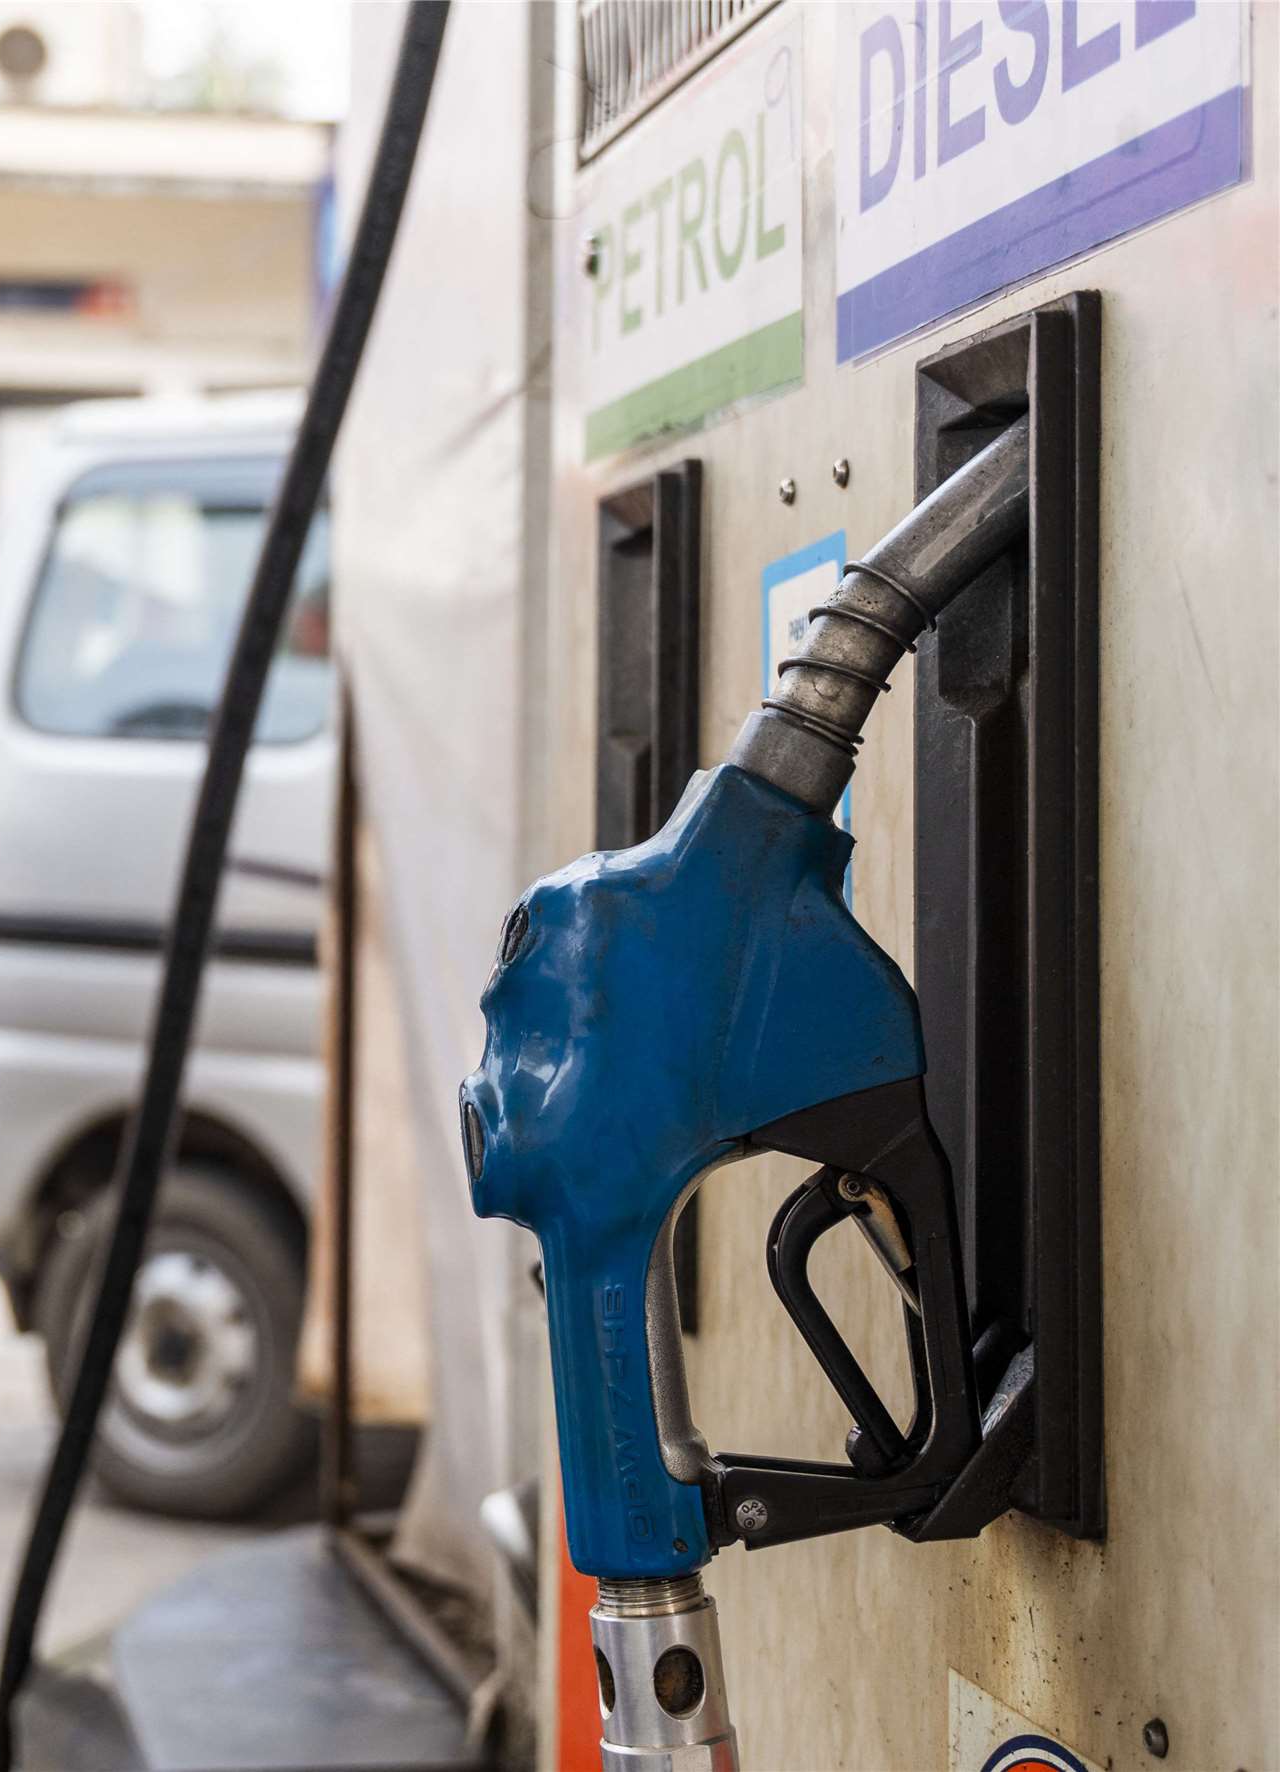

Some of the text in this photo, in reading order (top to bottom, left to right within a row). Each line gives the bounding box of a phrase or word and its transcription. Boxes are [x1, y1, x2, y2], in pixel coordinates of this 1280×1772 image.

[859, 0, 1196, 215] DIES
[592, 112, 785, 355] PETROL
[741, 1501, 767, 1517] OPW
